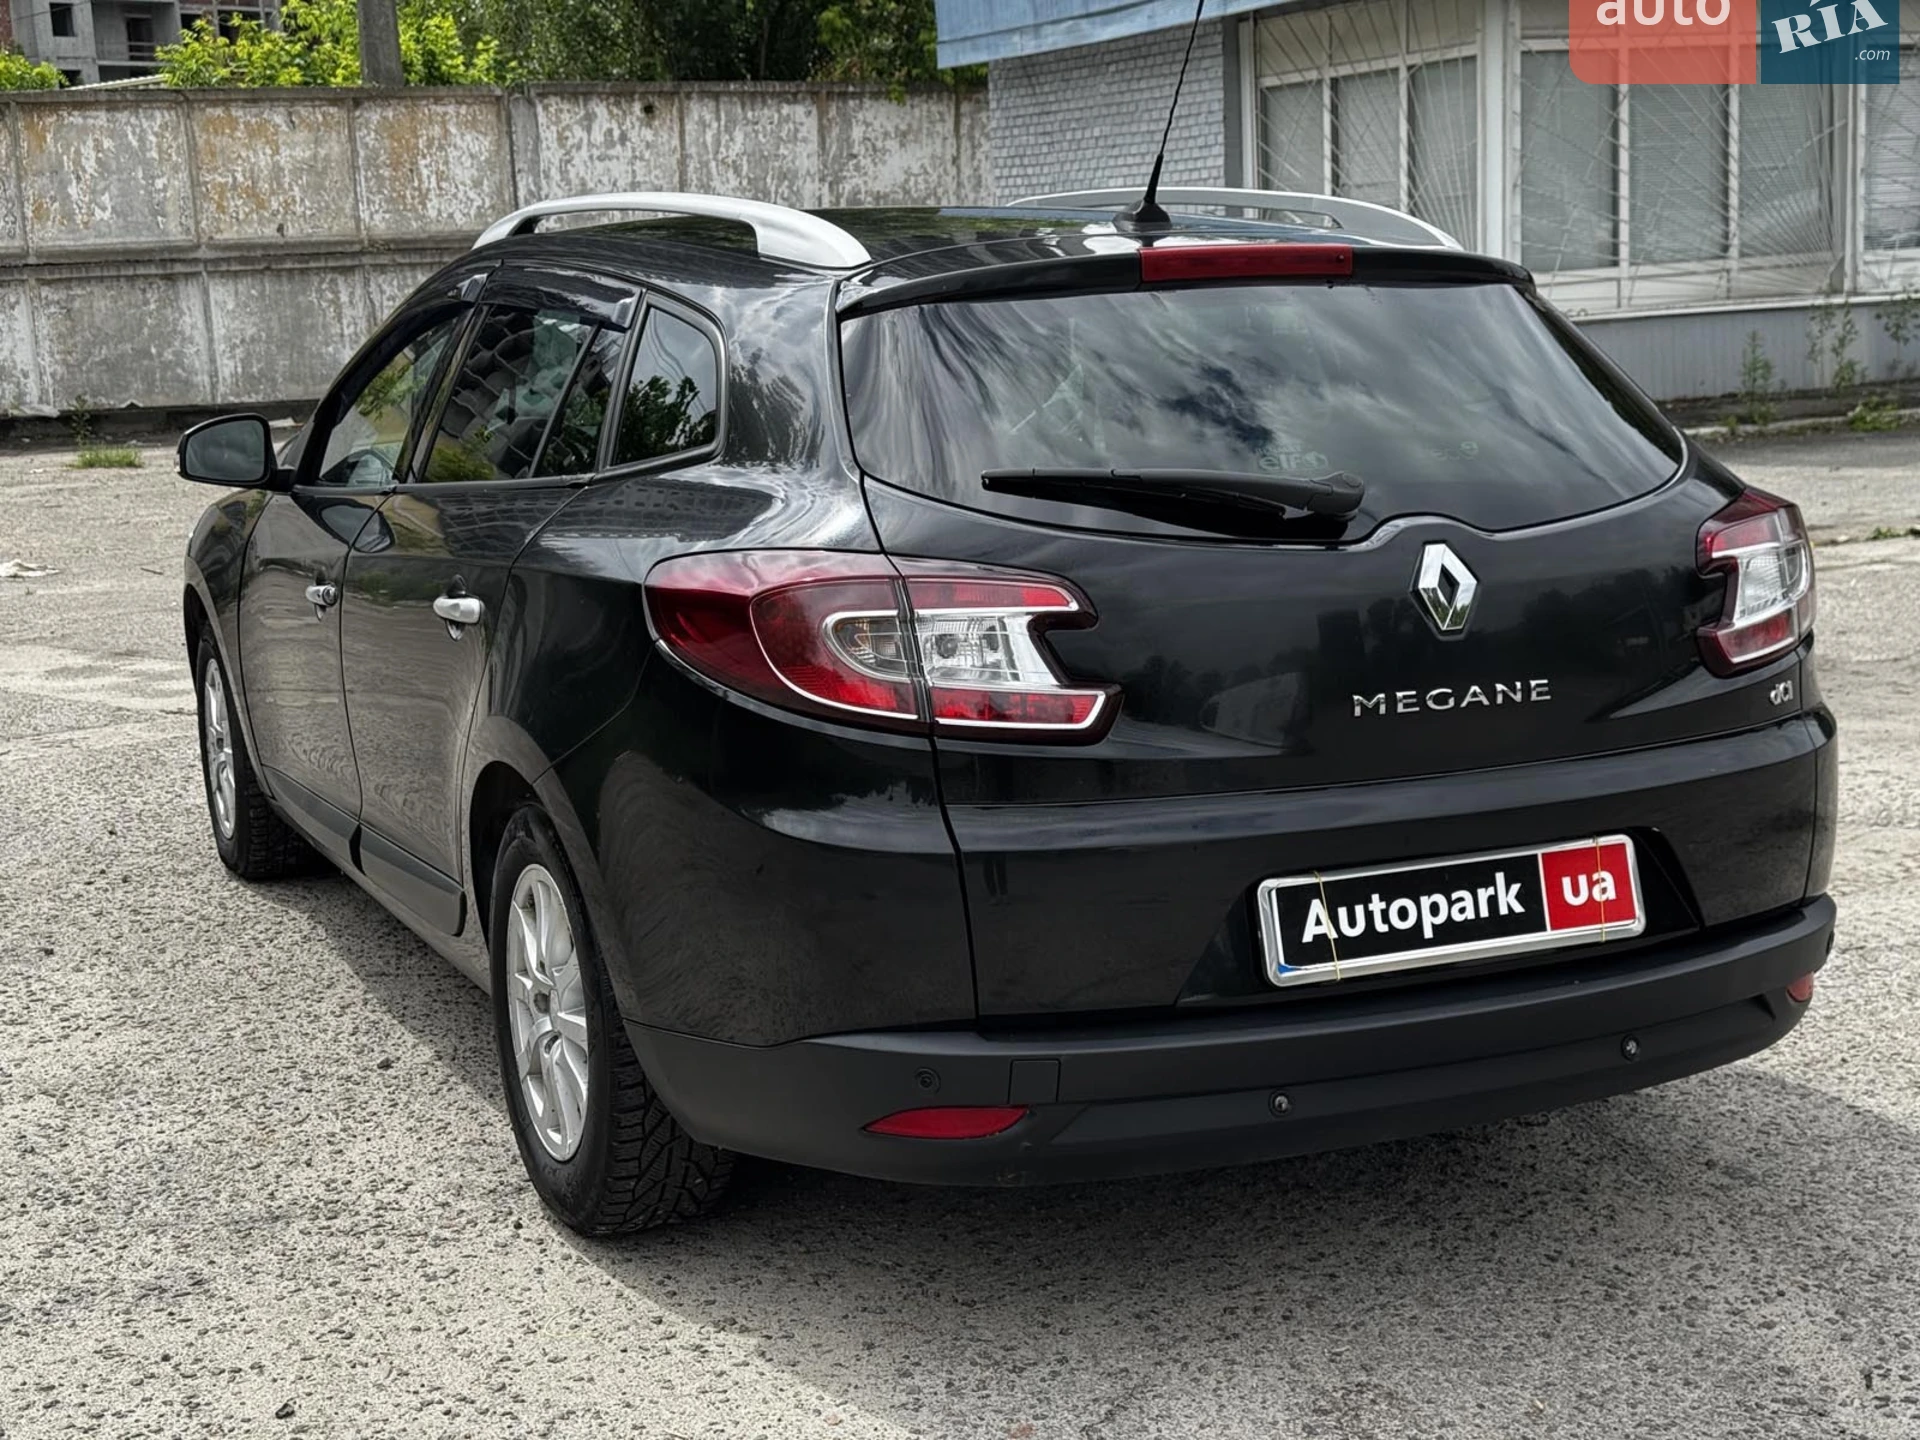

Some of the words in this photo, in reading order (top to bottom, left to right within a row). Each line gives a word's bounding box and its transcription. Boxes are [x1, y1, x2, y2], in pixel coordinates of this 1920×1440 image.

[1352, 679, 1552, 717] MEGANE
[1301, 871, 1526, 942] Autopark
[1561, 870, 1617, 907] ua
